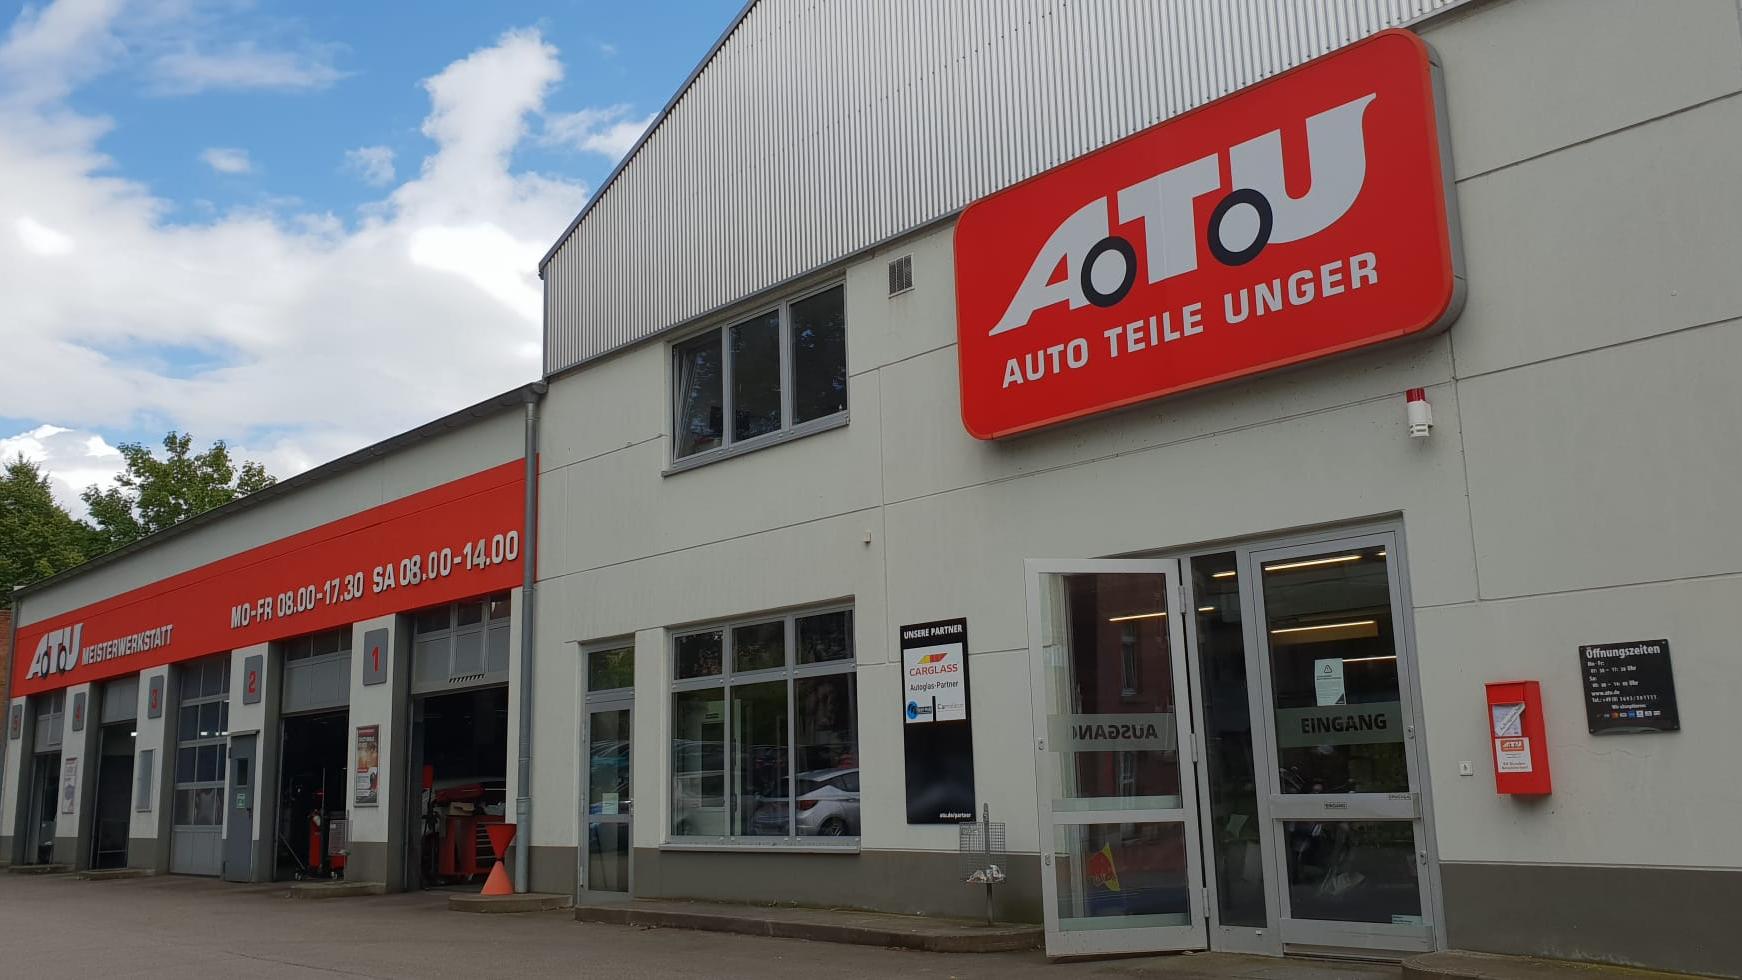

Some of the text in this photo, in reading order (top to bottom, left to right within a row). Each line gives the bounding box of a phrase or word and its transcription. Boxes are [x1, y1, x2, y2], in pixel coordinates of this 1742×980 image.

[1002, 251, 1379, 388] AUTO TEILE UNGER
[231, 531, 519, 629] MO-FR 08.00-17.30 SA 08.00-14.00
[904, 624, 962, 639] UNSERE PARTNER
[81, 624, 174, 665] MEISTERWERKSTATT
[1586, 644, 1661, 659] Öffnungszeiten
[371, 646, 380, 673] 1
[909, 663, 958, 677] CARGLASS
[248, 671, 256, 694] 2
[151, 688, 159, 711] 3
[1301, 713, 1387, 734] EINGANG
